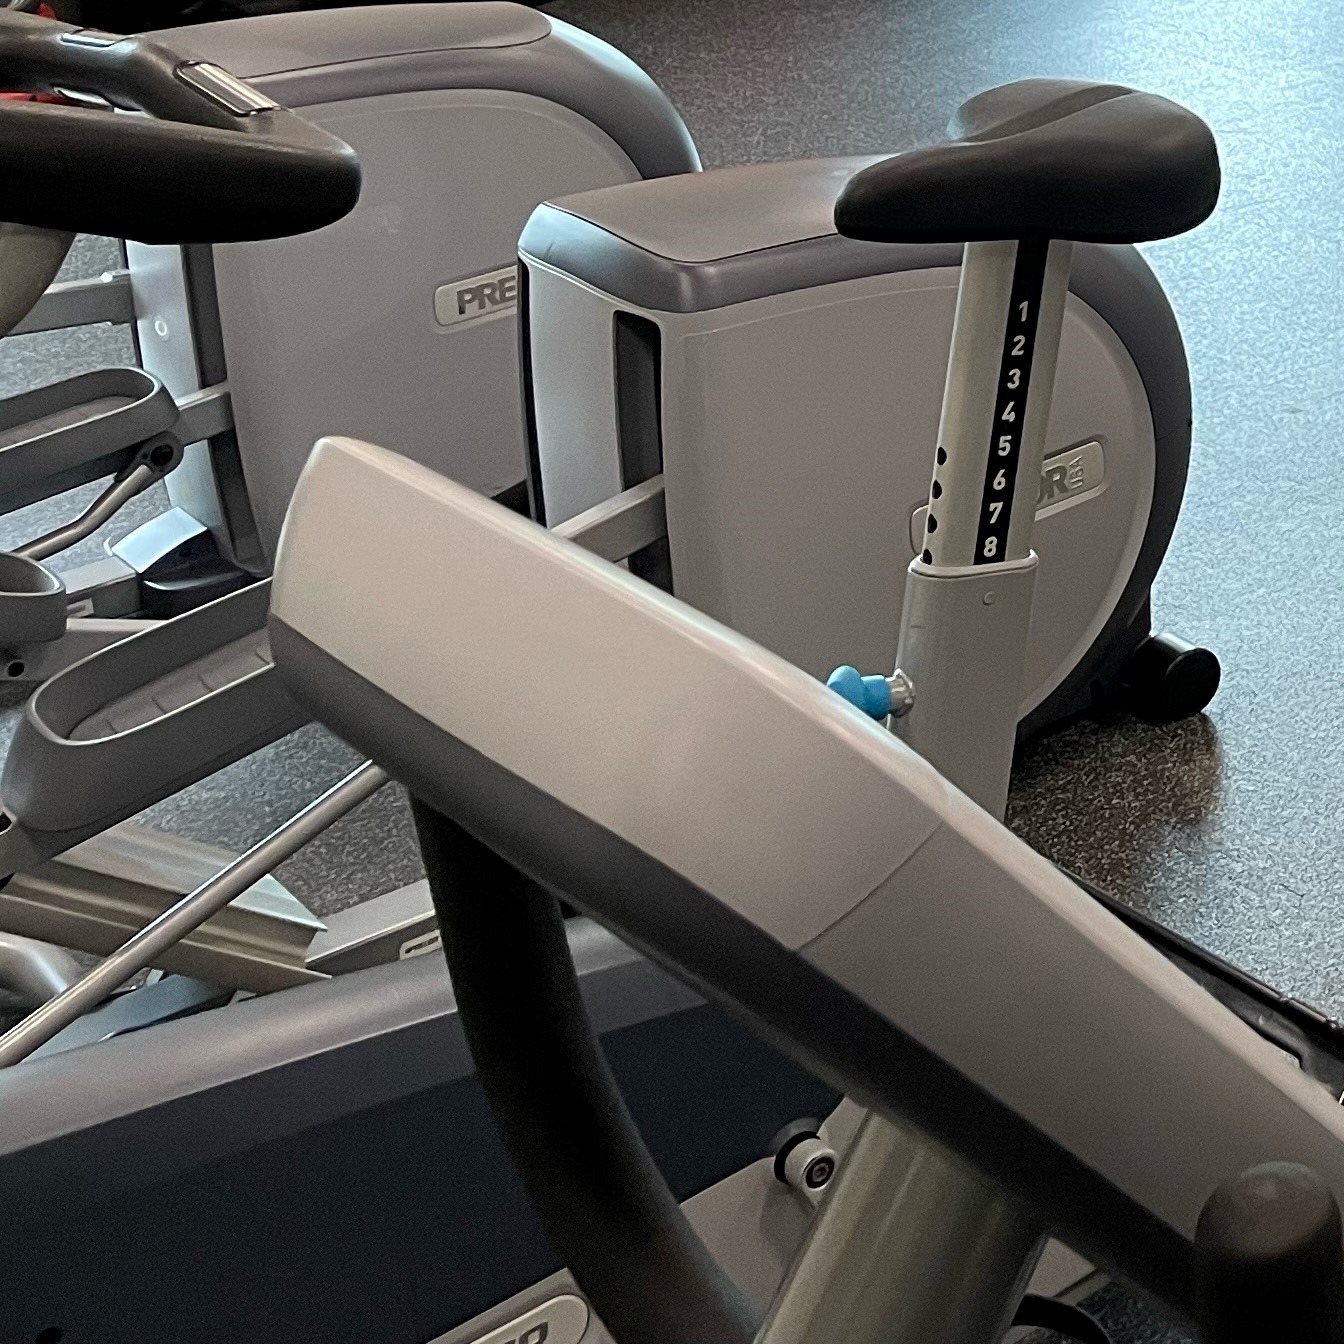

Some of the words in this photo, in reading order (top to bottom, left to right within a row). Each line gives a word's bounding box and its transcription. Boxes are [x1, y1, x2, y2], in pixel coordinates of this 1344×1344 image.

[457, 275, 516, 315] PRE
[1019, 301, 1029, 322] 1
[1011, 335, 1025, 356] 2
[1007, 368, 1021, 389] 3
[1001, 401, 1015, 422] 4
[998, 435, 1012, 456] 5
[993, 469, 1006, 490] 6
[989, 501, 1003, 524] 7
[983, 536, 997, 557] 8
